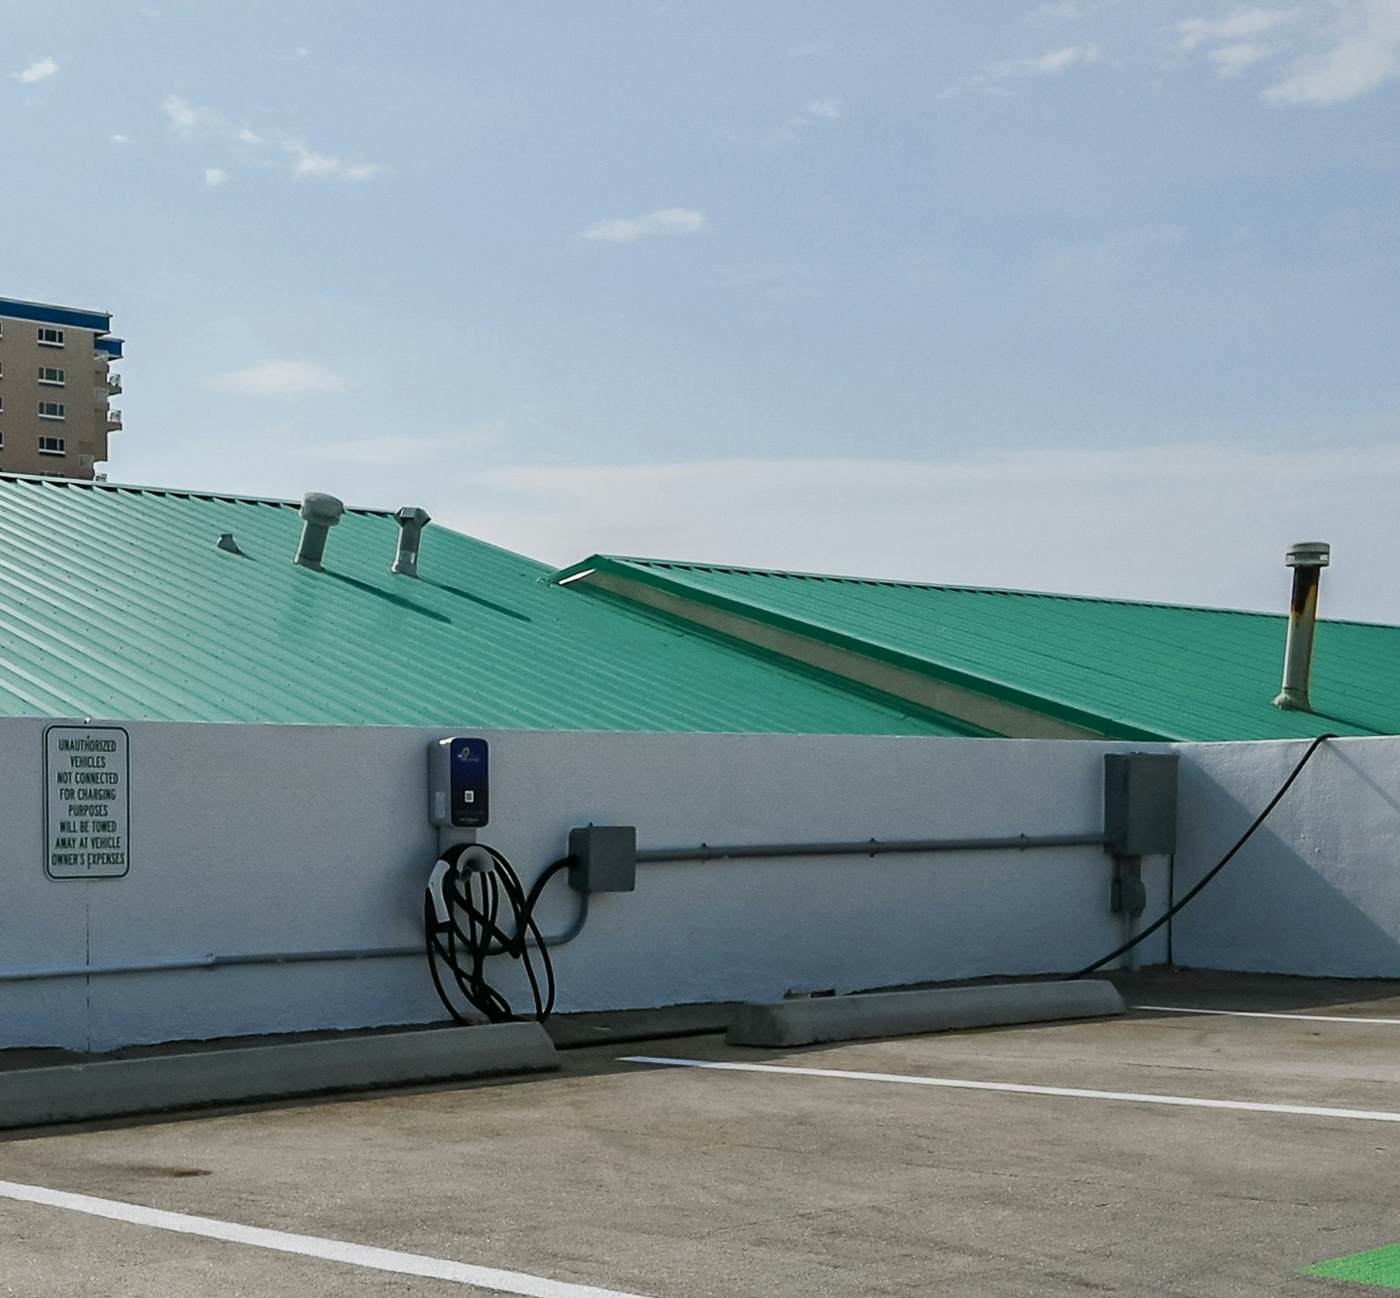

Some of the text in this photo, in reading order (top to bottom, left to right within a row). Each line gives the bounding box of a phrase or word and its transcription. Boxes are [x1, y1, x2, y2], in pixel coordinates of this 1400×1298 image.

[58, 739, 117, 752] UNAUTHORIZED
[70, 756, 106, 769] VEHICLES
[57, 772, 119, 785] NOT CONNECTED
[59, 788, 116, 801] FOR CHARGING
[68, 804, 108, 817] PURPOSES
[60, 821, 117, 833] WILL BE TOWED
[55, 837, 121, 849] AWAY AT VEHICLE
[51, 853, 85, 866] OWNER'S
